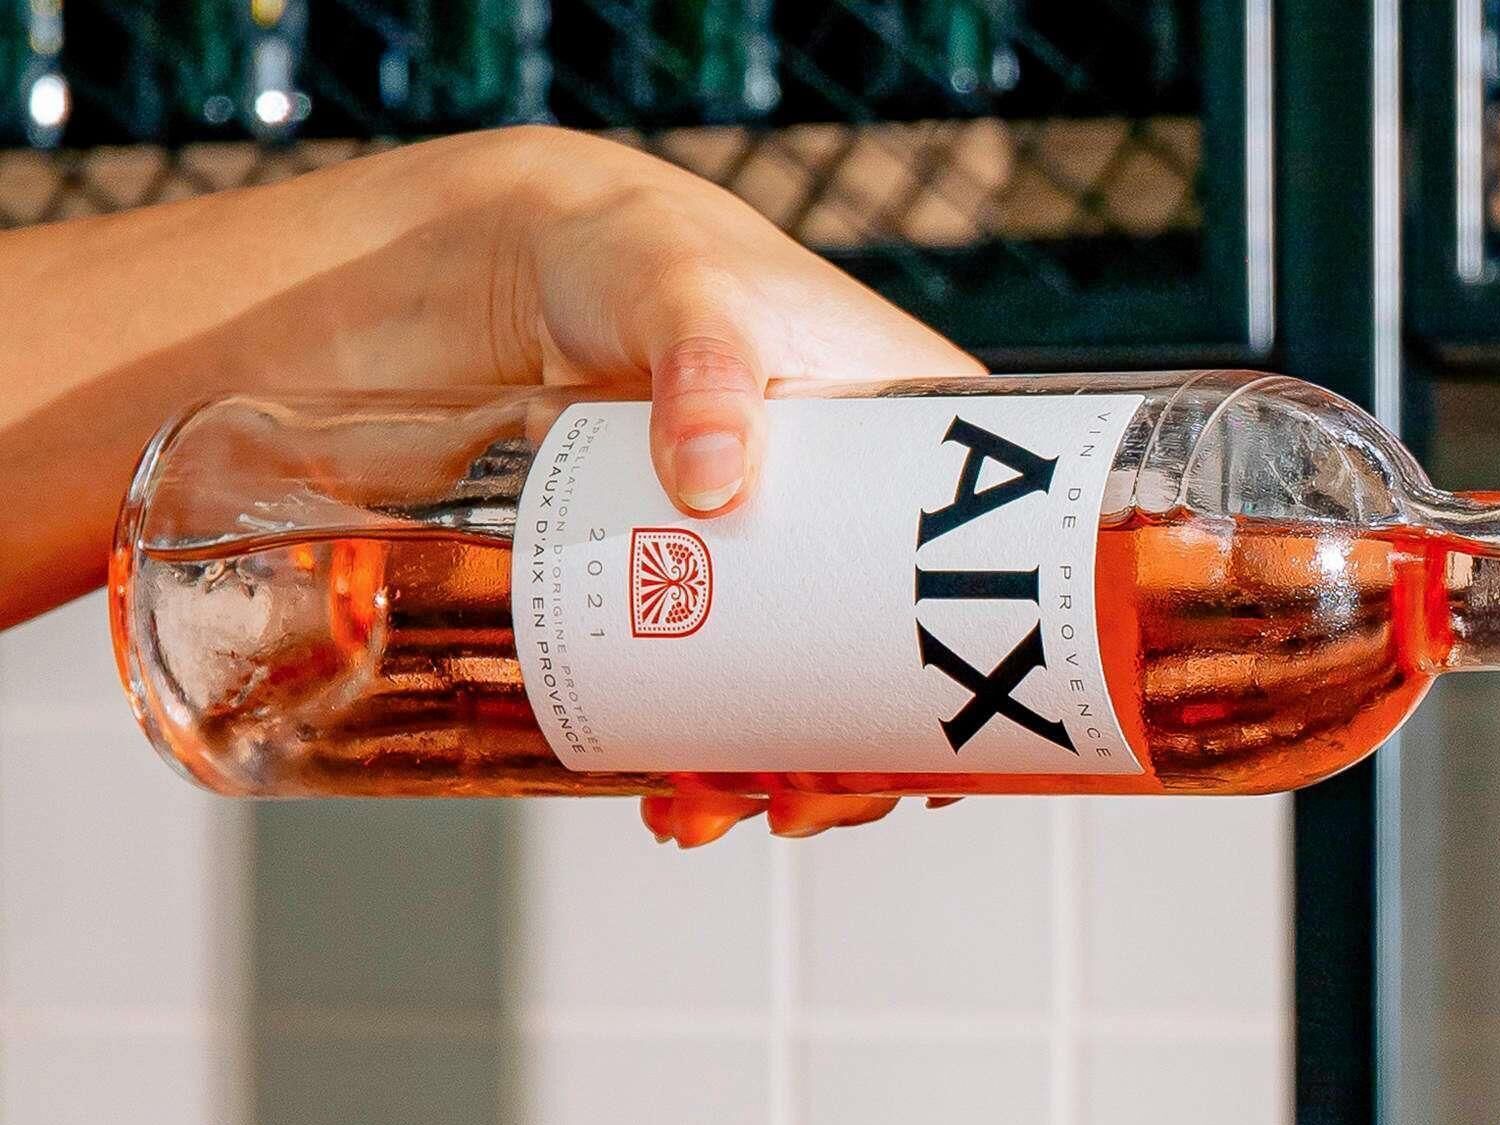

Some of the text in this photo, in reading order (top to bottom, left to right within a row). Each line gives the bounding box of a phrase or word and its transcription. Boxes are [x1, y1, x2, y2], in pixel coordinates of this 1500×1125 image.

[532, 418, 588, 754] COTEAUX D'AIX EN PROVENCE
[556, 418, 605, 531] APPELLATION
[587, 527, 605, 638] 2021
[915, 414, 1080, 756] AIX
[1059, 412, 1111, 758] VIN DE PROVENCE
[552, 544, 567, 653] D'ORIGINE
